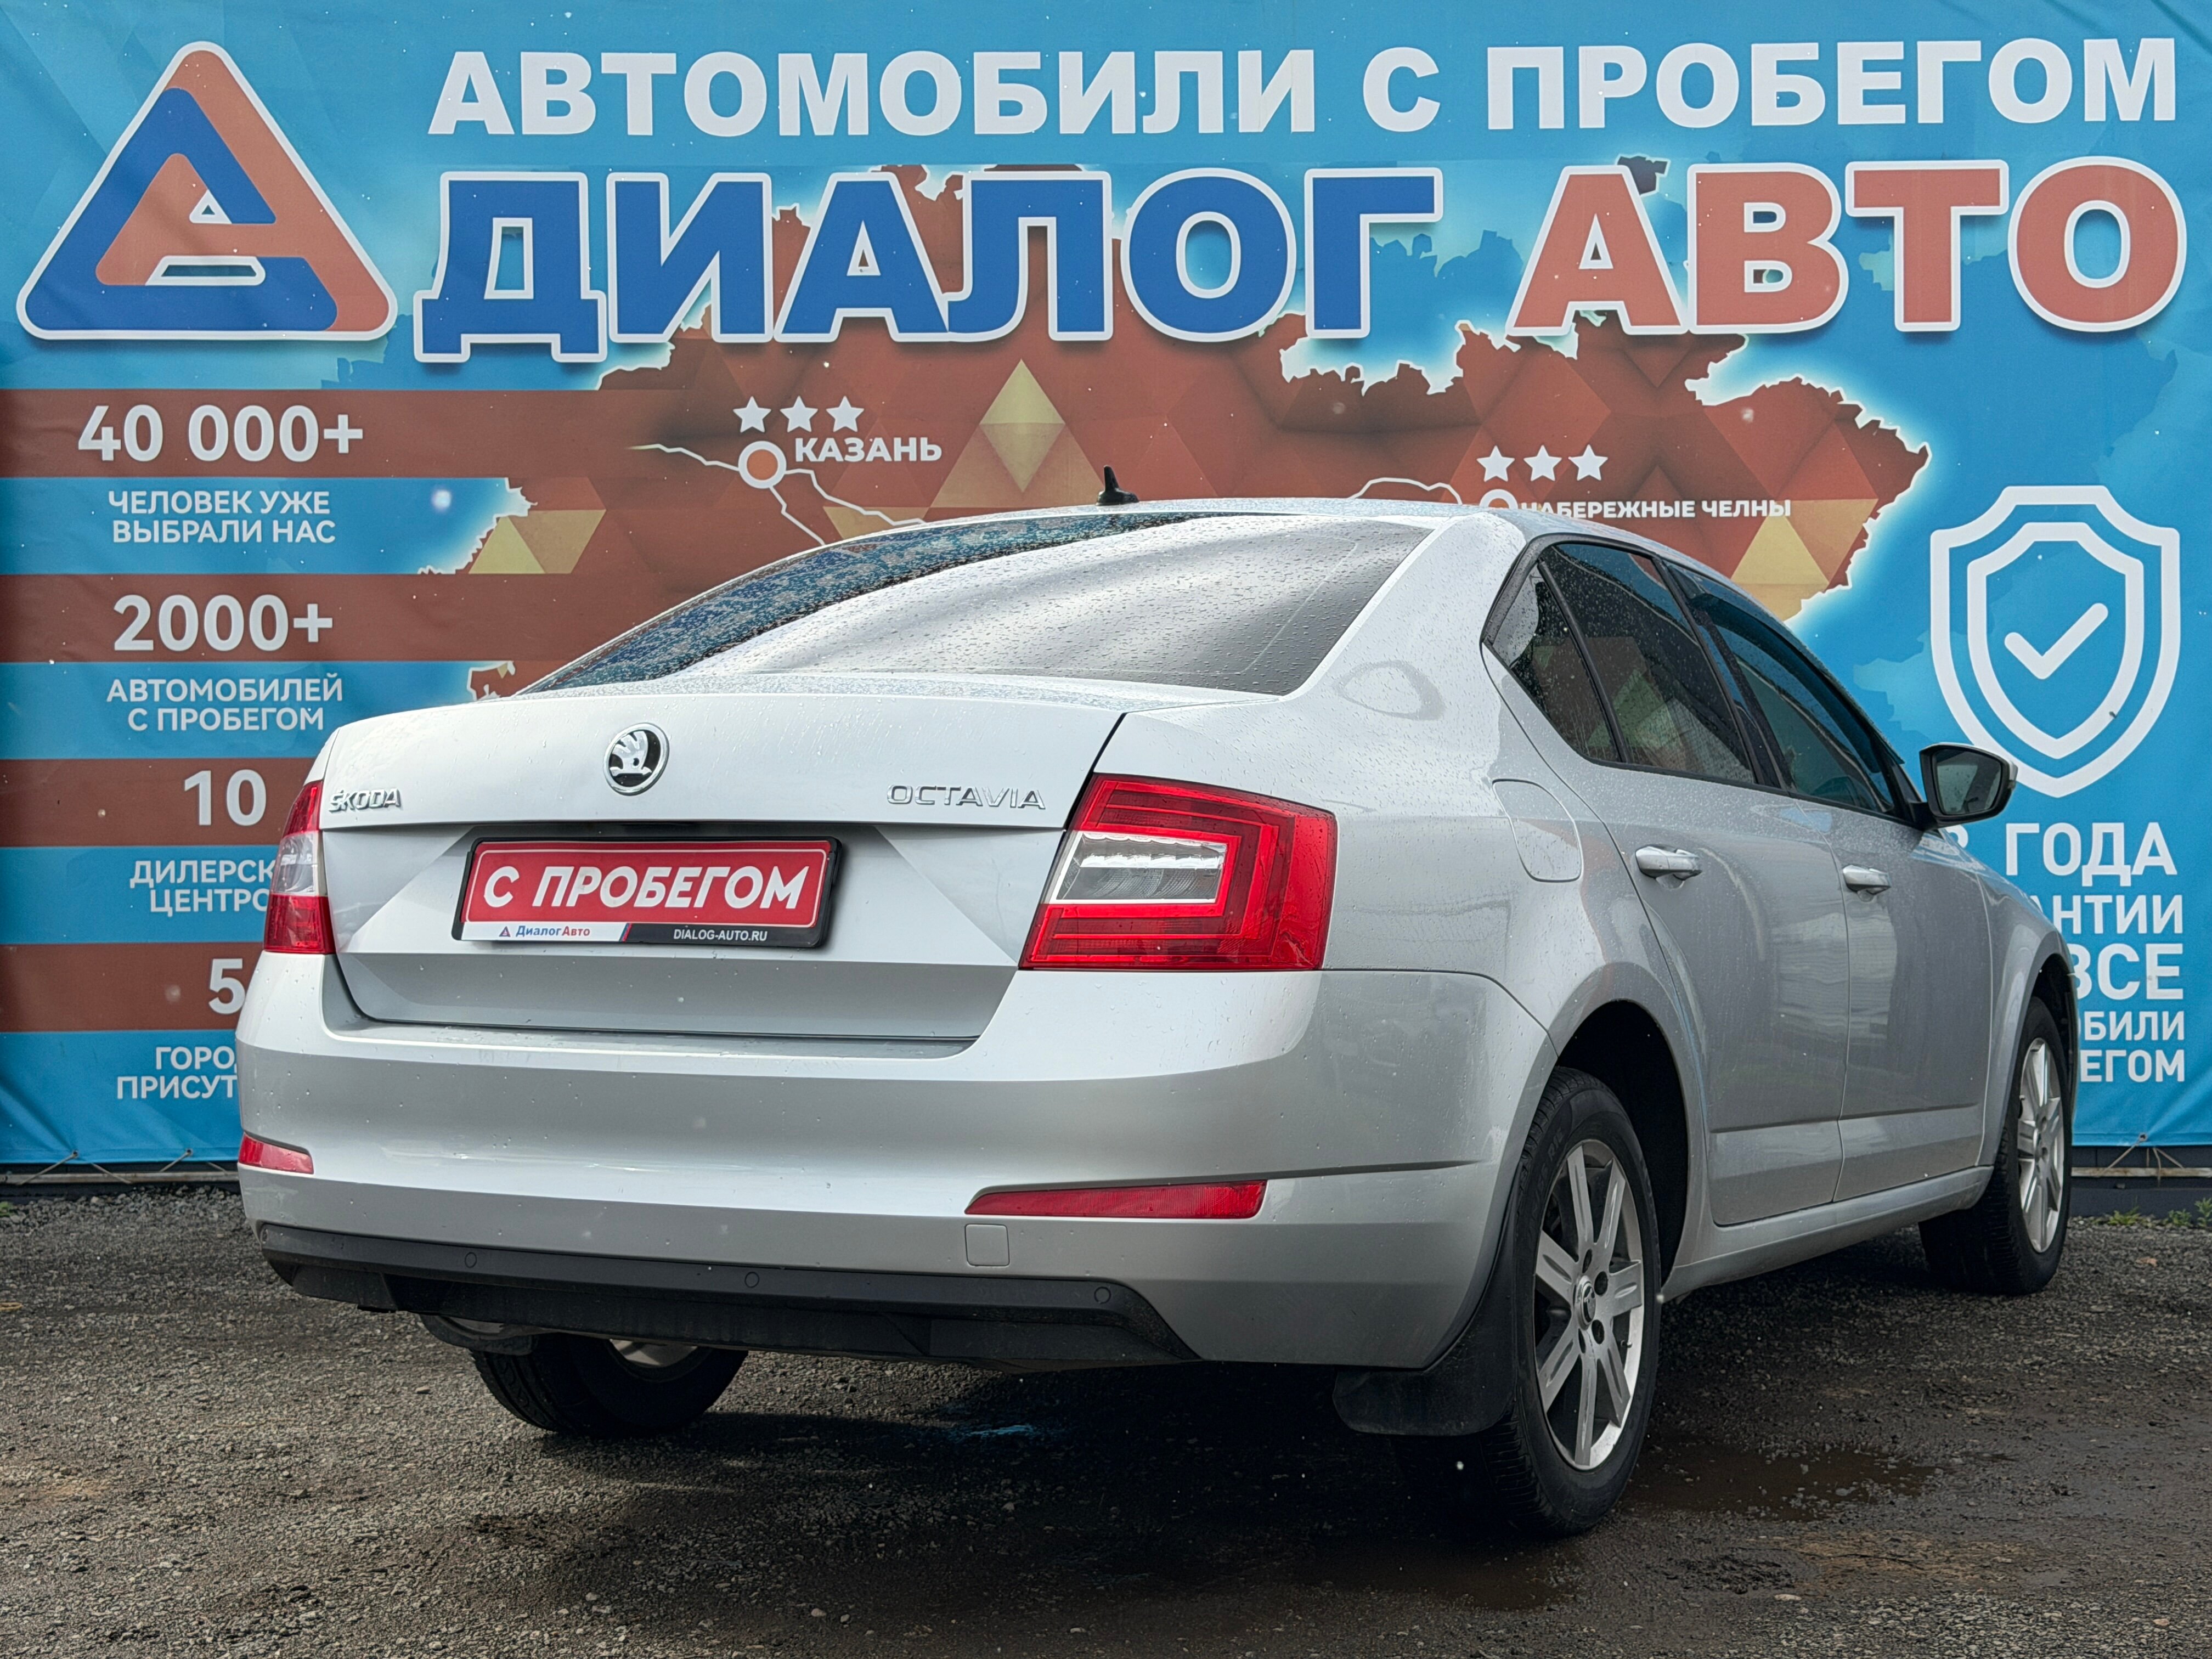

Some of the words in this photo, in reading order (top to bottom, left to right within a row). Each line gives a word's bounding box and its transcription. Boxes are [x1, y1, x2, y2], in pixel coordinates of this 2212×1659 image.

[427, 49, 1315, 137] АВТОМОБИЛИ
[1363, 47, 1441, 132] С
[1487, 37, 2176, 130] ПРОБЕГОМ
[413, 167, 1443, 363] ДИАЛОГ
[1505, 156, 2187, 335] АВТО
[78, 404, 163, 461] 40
[188, 404, 363, 462] 000+
[795, 437, 942, 462] КАЗАНЬ
[109, 490, 252, 514] ЧЕЛОВЕК
[259, 490, 330, 514] УЖЕ
[1702, 499, 1791, 517] ЧЕЛНЫ
[113, 520, 262, 543] ВЫБРАЛИ
[273, 520, 335, 543] НАС
[114, 594, 333, 651] 2000+
[106, 673, 342, 702] АВТОМОБИЛЕЙ
[128, 708, 148, 731] С
[157, 707, 323, 731] ПРОБЕГОМ
[184, 769, 267, 826] 10
[887, 784, 1046, 809] OCTAVIA
[2006, 822, 2177, 887] ГОДА
[483, 866, 520, 908] С
[532, 866, 809, 909] ПРОБЕГОМ
[673, 929, 768, 941] DIALOG-AUTO.RU
[208, 958, 245, 1015] 5
[2079, 1011, 2185, 1041] БИЛИ
[156, 1046, 237, 1074] ГОРО
